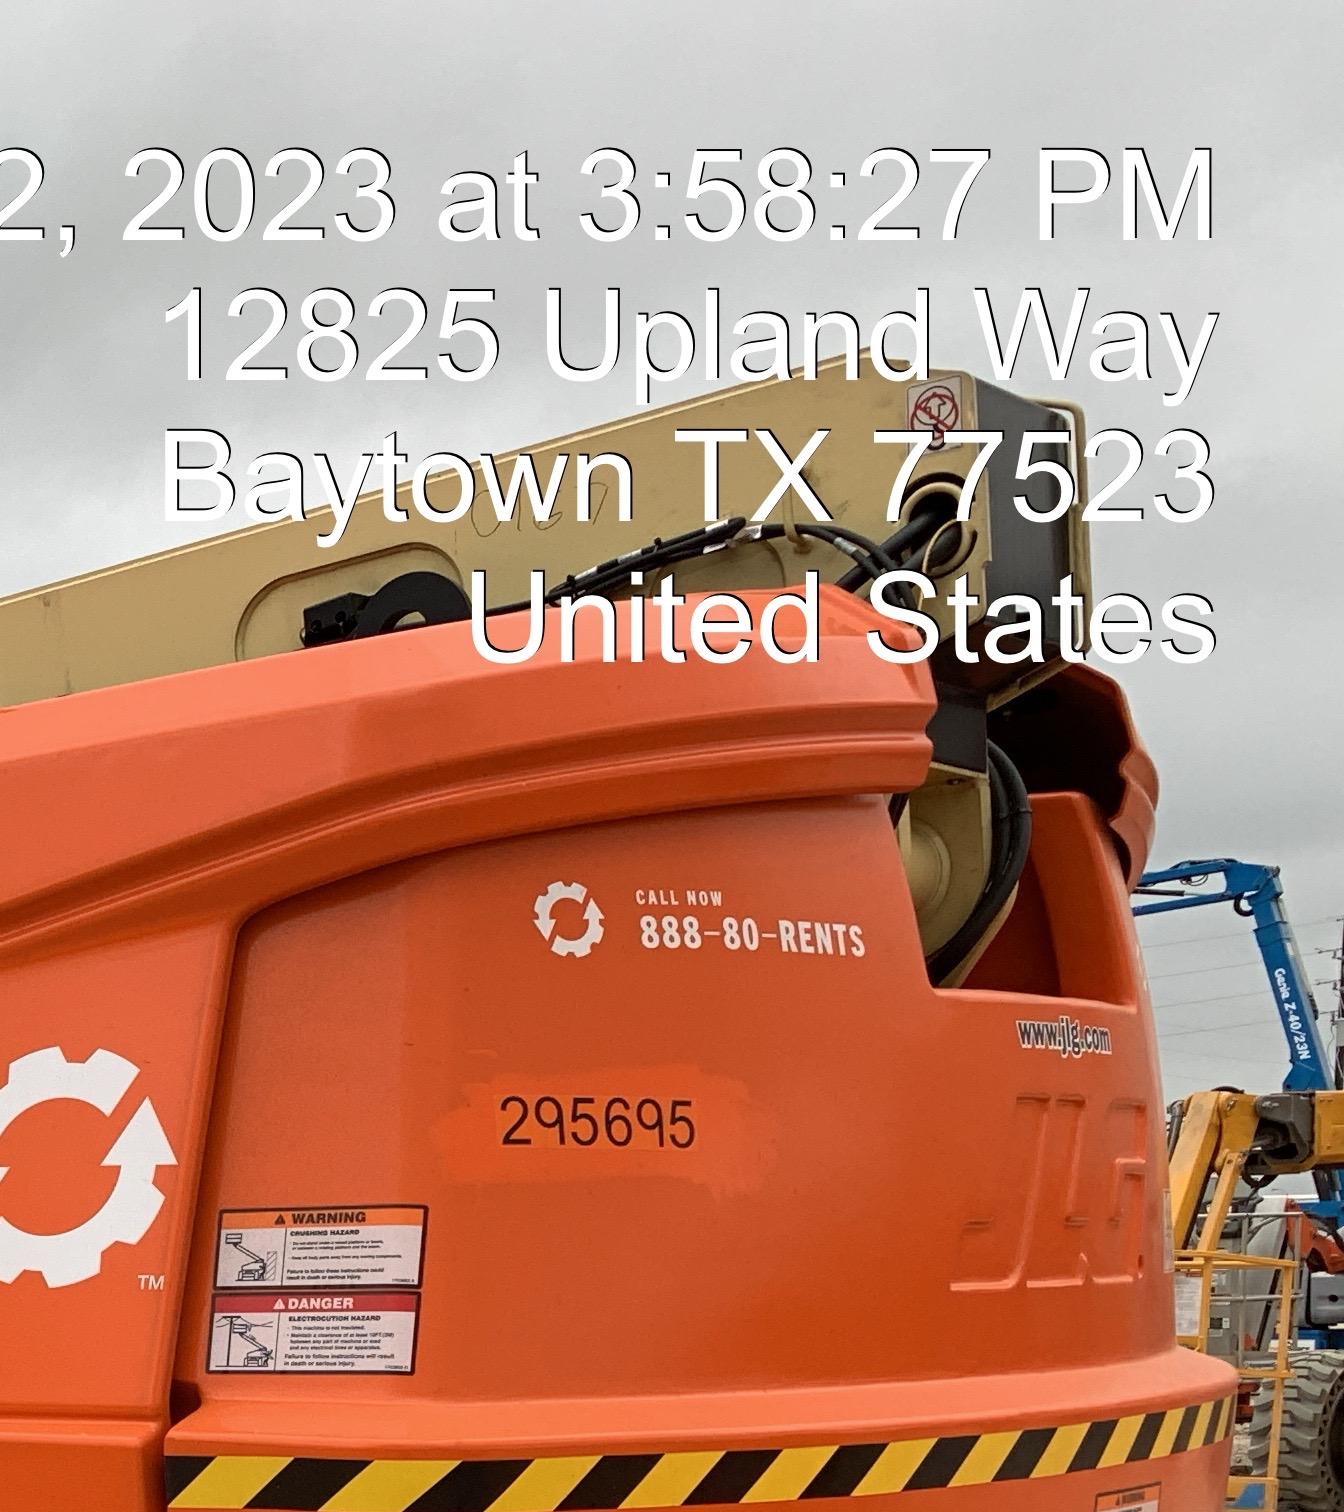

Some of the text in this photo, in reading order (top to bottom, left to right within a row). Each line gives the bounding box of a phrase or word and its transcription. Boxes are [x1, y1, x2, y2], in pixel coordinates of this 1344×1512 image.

[635, 889, 723, 907] CALL NOW
[639, 914, 867, 958] 888-80-RENTS
[1016, 1016, 1112, 1058] www.jlg.com
[500, 1095, 696, 1148] 295695
[291, 1211, 367, 1225] WARNING
[137, 1274, 165, 1290] TM
[287, 1297, 354, 1310] DANGER
